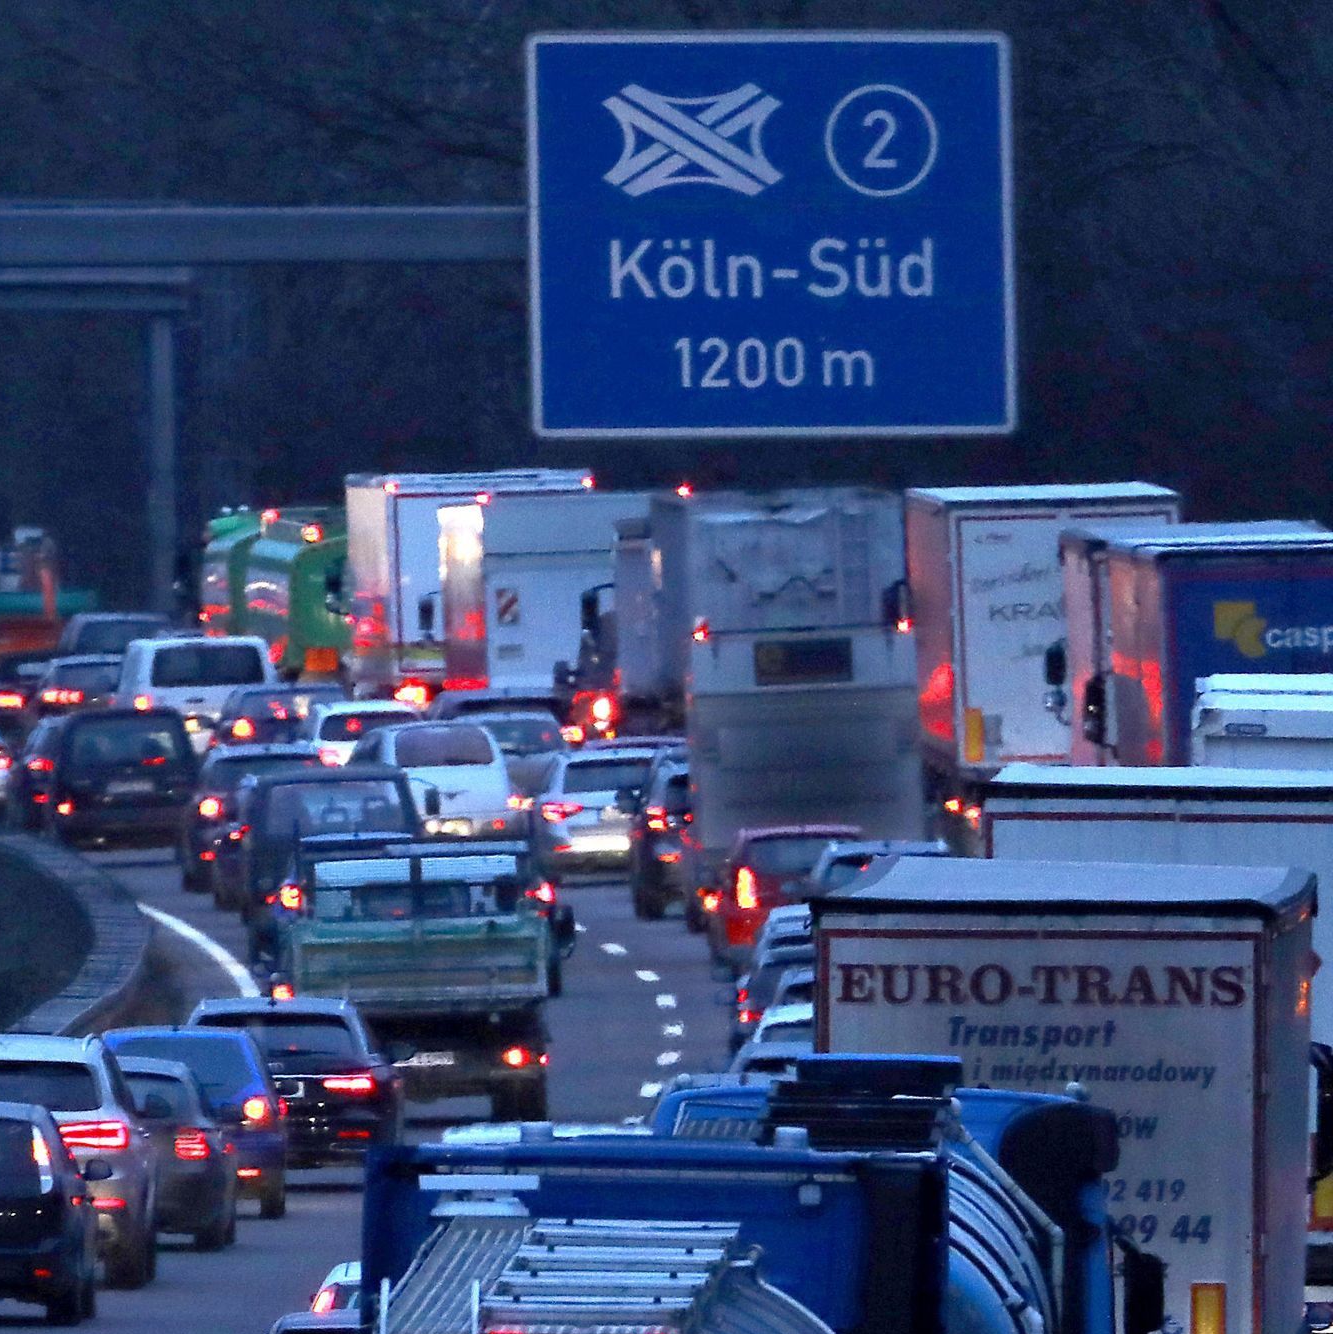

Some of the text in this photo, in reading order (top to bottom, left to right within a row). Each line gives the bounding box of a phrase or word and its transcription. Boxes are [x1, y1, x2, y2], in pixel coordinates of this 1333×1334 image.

[862, 109, 898, 169] 2
[608, 236, 935, 299] Köln-Süd
[673, 336, 875, 389] 1200 m
[834, 962, 1247, 1008] EURO-TRANS
[947, 1016, 1117, 1055] Transport
[991, 1057, 1217, 1089] międzynarodowy
[1135, 1178, 1186, 1202] 419
[1170, 1213, 1213, 1245] 44
